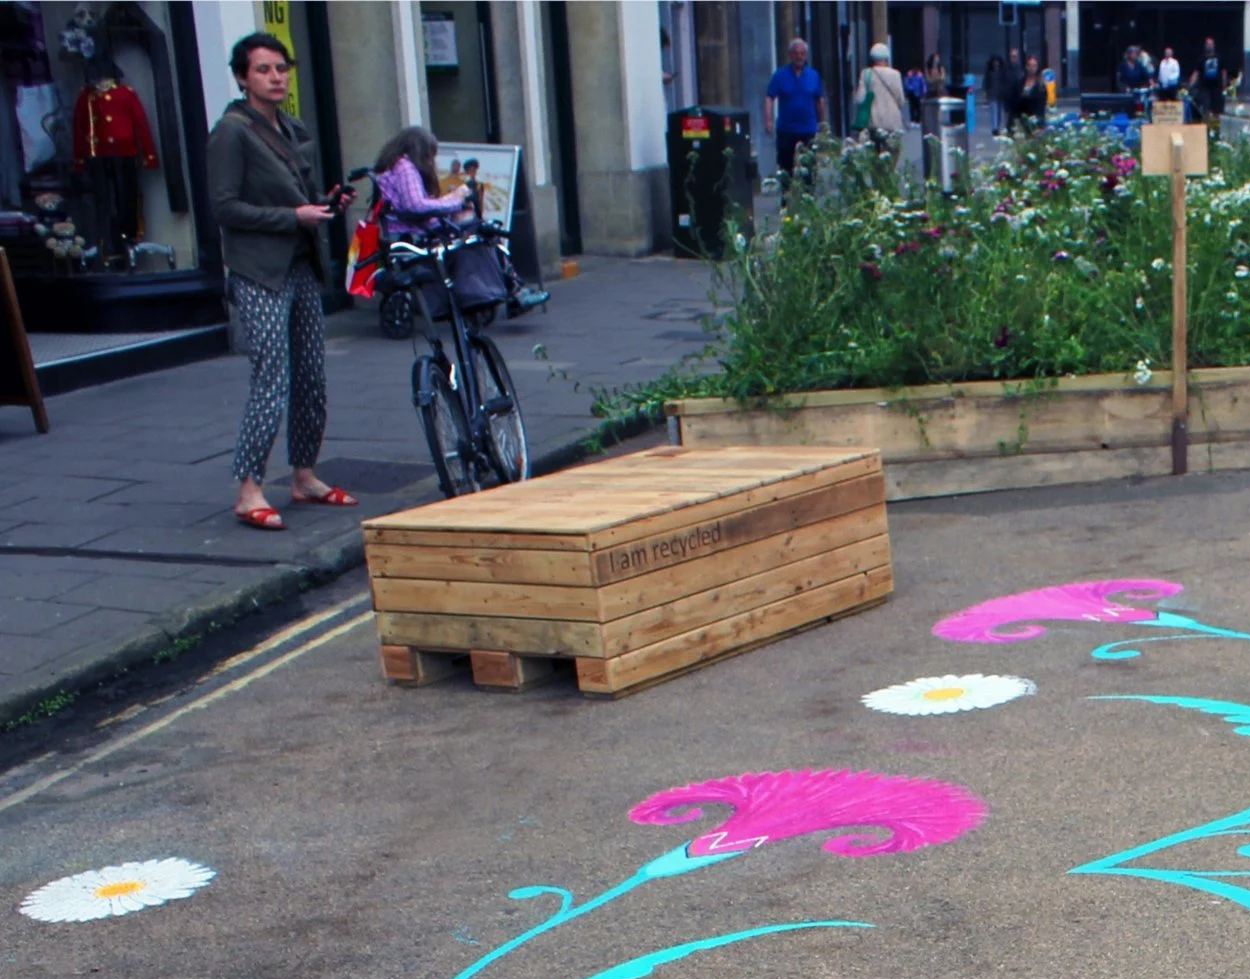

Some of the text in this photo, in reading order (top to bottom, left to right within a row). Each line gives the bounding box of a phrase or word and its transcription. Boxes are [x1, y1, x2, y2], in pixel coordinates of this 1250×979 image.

[609, 521, 721, 573] I am recycled
